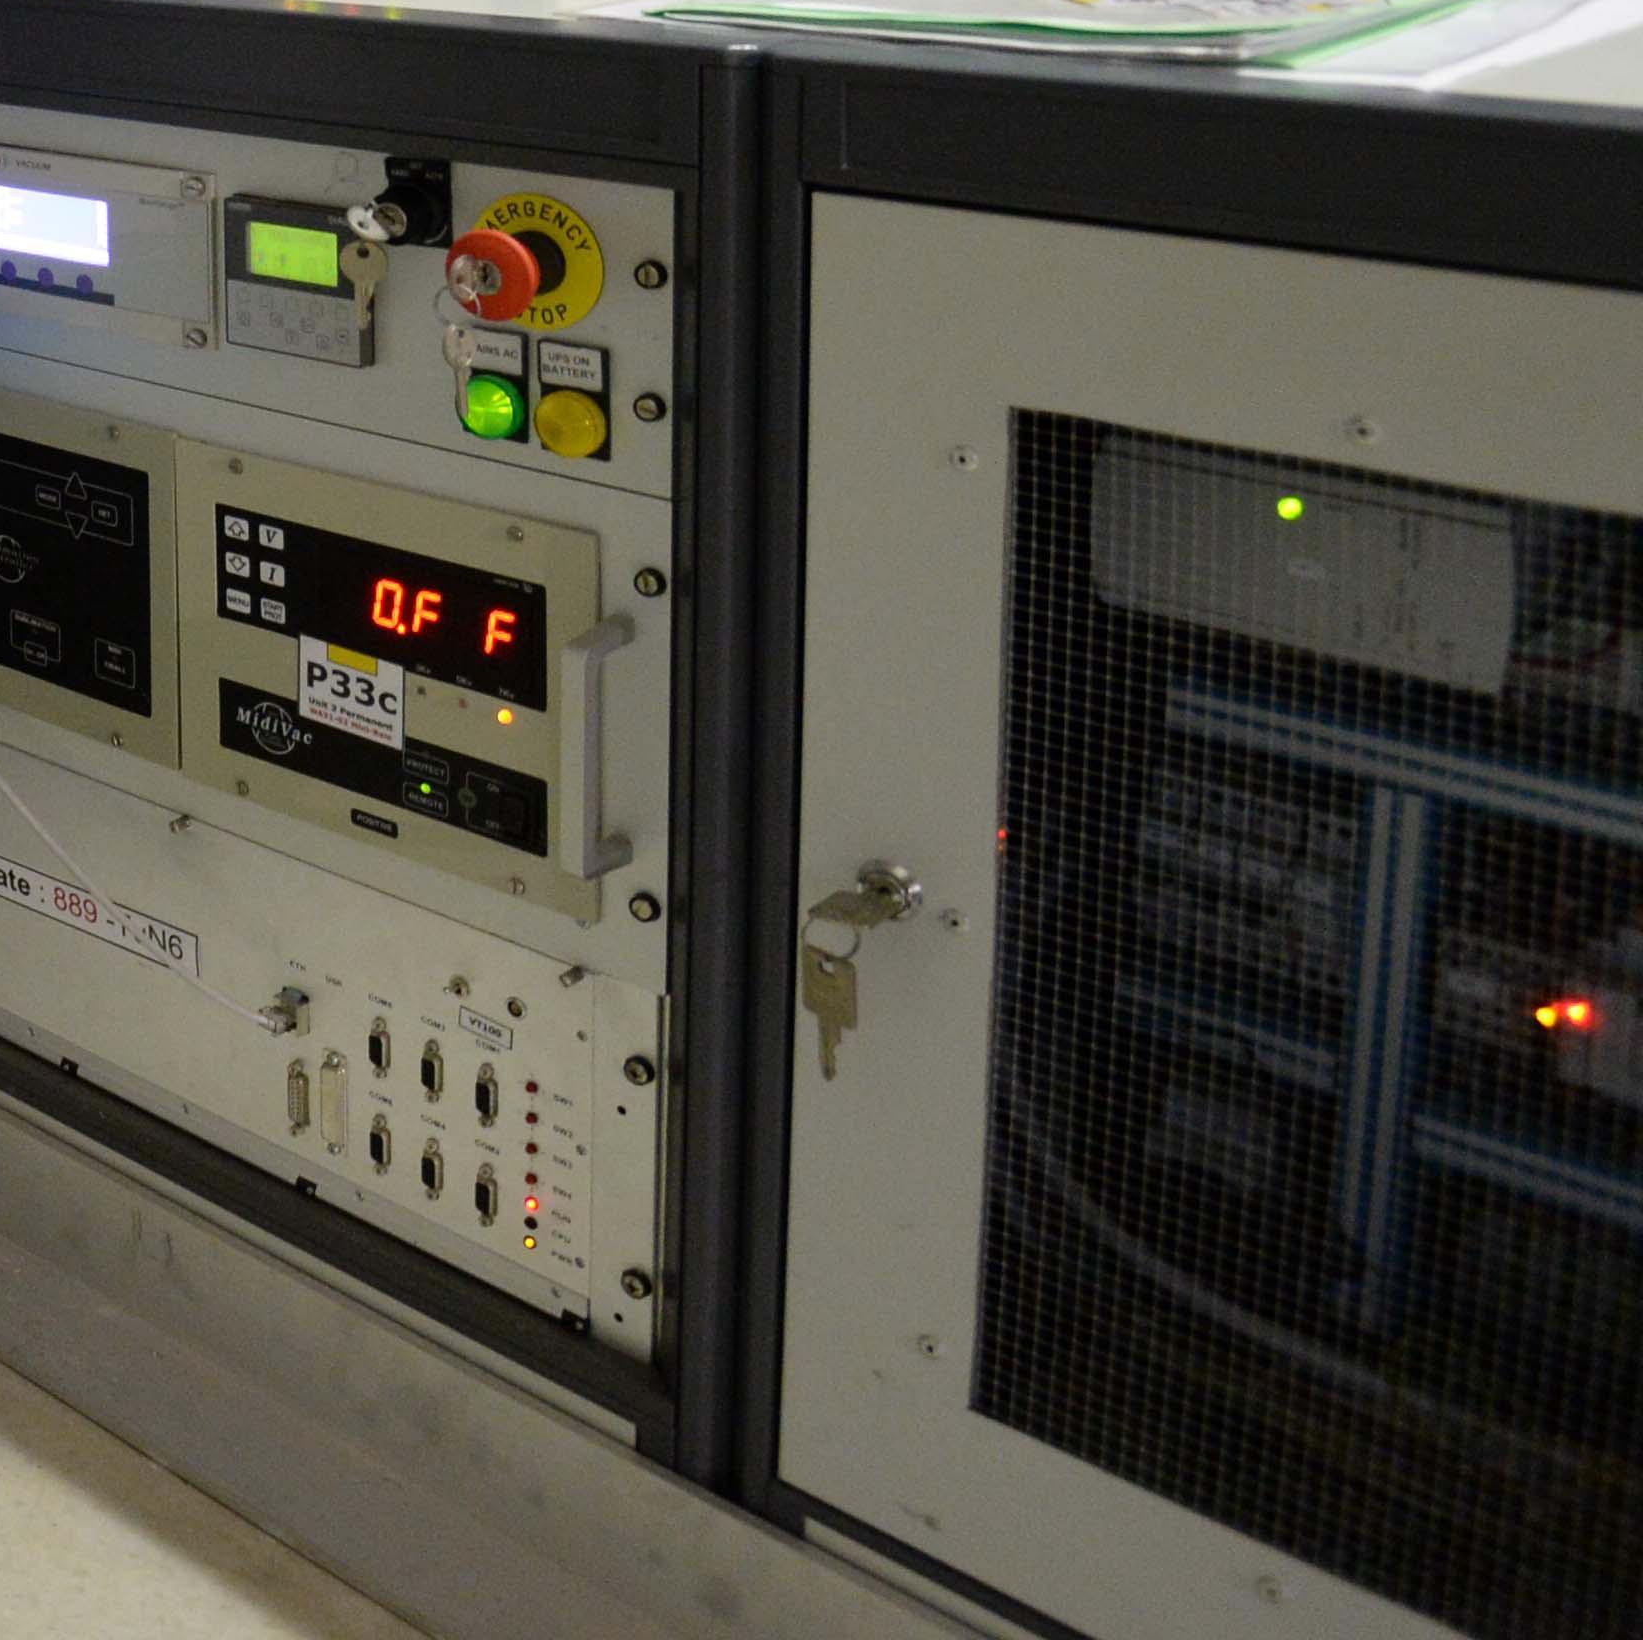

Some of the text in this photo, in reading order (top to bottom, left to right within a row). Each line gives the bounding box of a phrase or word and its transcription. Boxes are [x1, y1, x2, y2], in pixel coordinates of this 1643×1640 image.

[16, 160, 52, 171] VACUUM
[519, 303, 567, 324] TOP
[476, 344, 500, 356] AINS
[548, 352, 590, 366] UPS ON
[542, 363, 595, 378] BATTERY
[266, 529, 277, 545] V
[268, 567, 276, 581] I
[307, 661, 397, 715] P33c
[236, 706, 313, 745] MidiVac
[406, 758, 444, 778] PROTECT
[53, 887, 98, 923] 889
[468, 1016, 503, 1039] VT100
[551, 1210, 572, 1224] RUN
[551, 1229, 572, 1244] CPU
